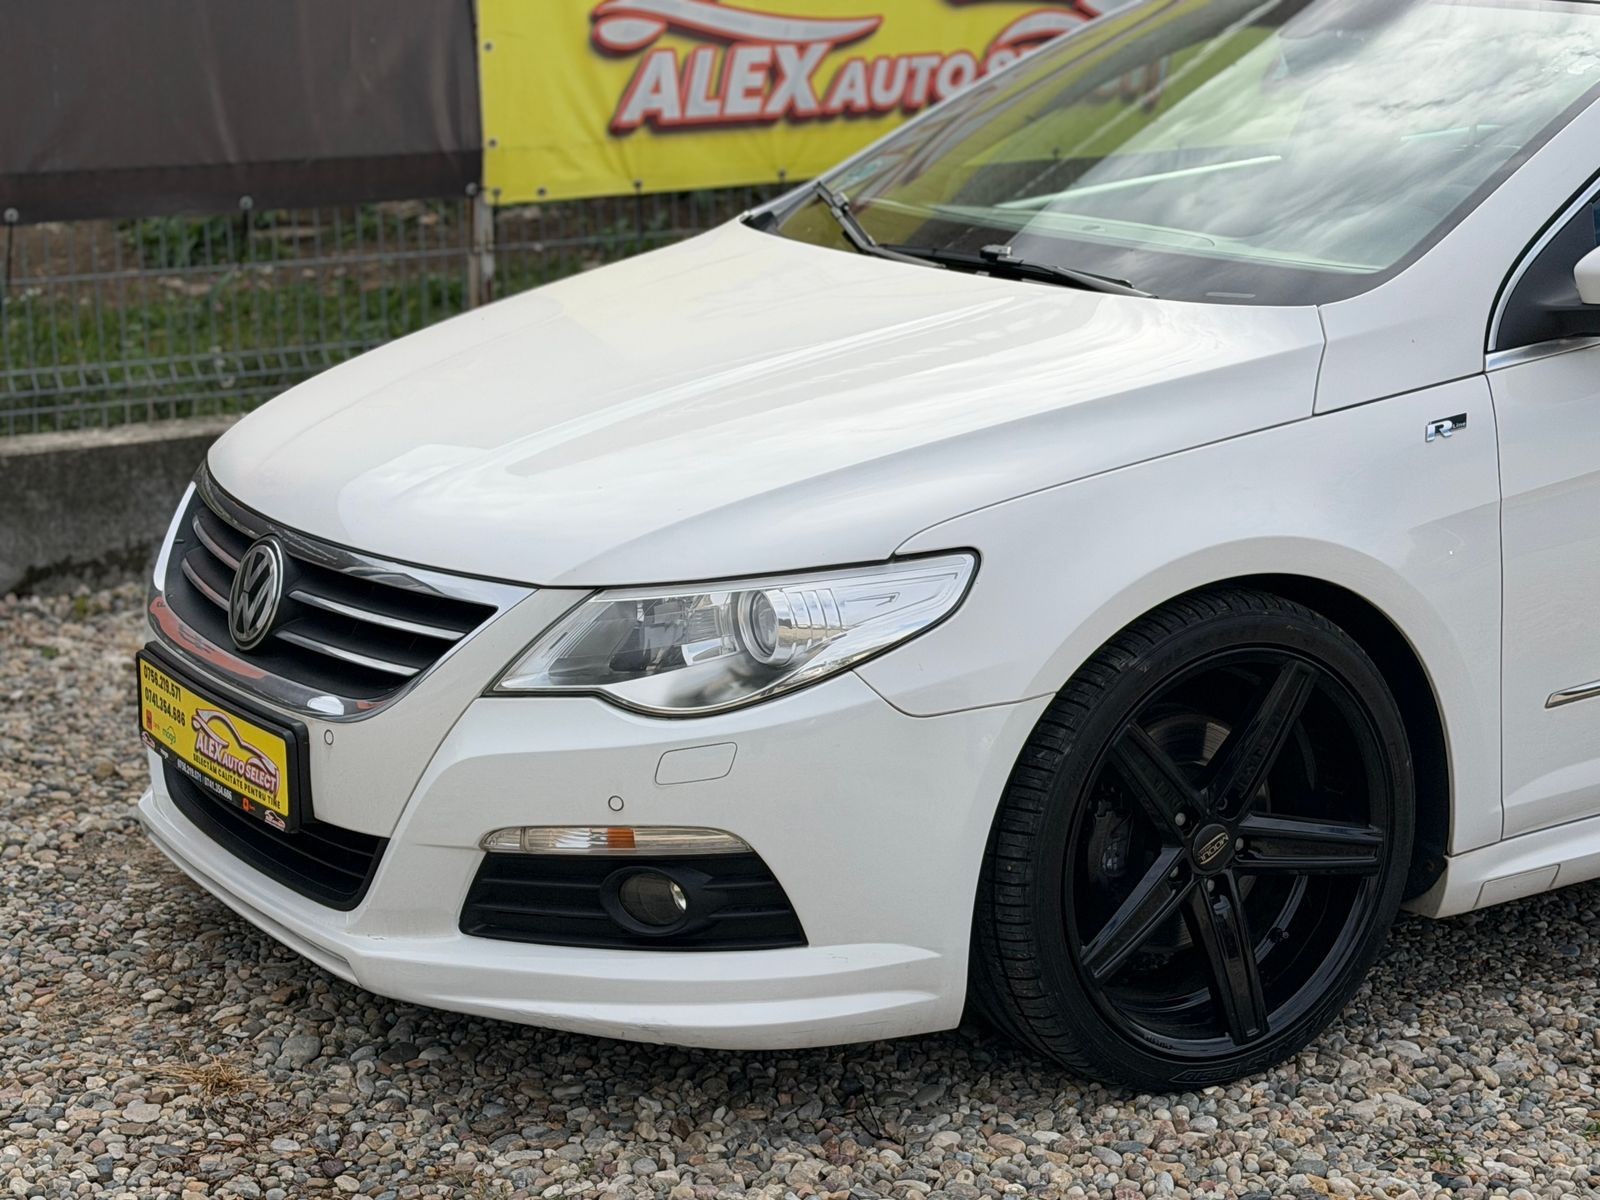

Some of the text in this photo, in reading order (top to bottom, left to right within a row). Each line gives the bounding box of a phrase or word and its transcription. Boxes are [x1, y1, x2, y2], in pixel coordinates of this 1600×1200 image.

[614, 40, 832, 126] ALEX
[829, 51, 977, 110] AUTO
[1425, 420, 1453, 442] R
[195, 731, 277, 792] ALEX AUTO SELECT
[243, 780, 267, 799] PENTRU
